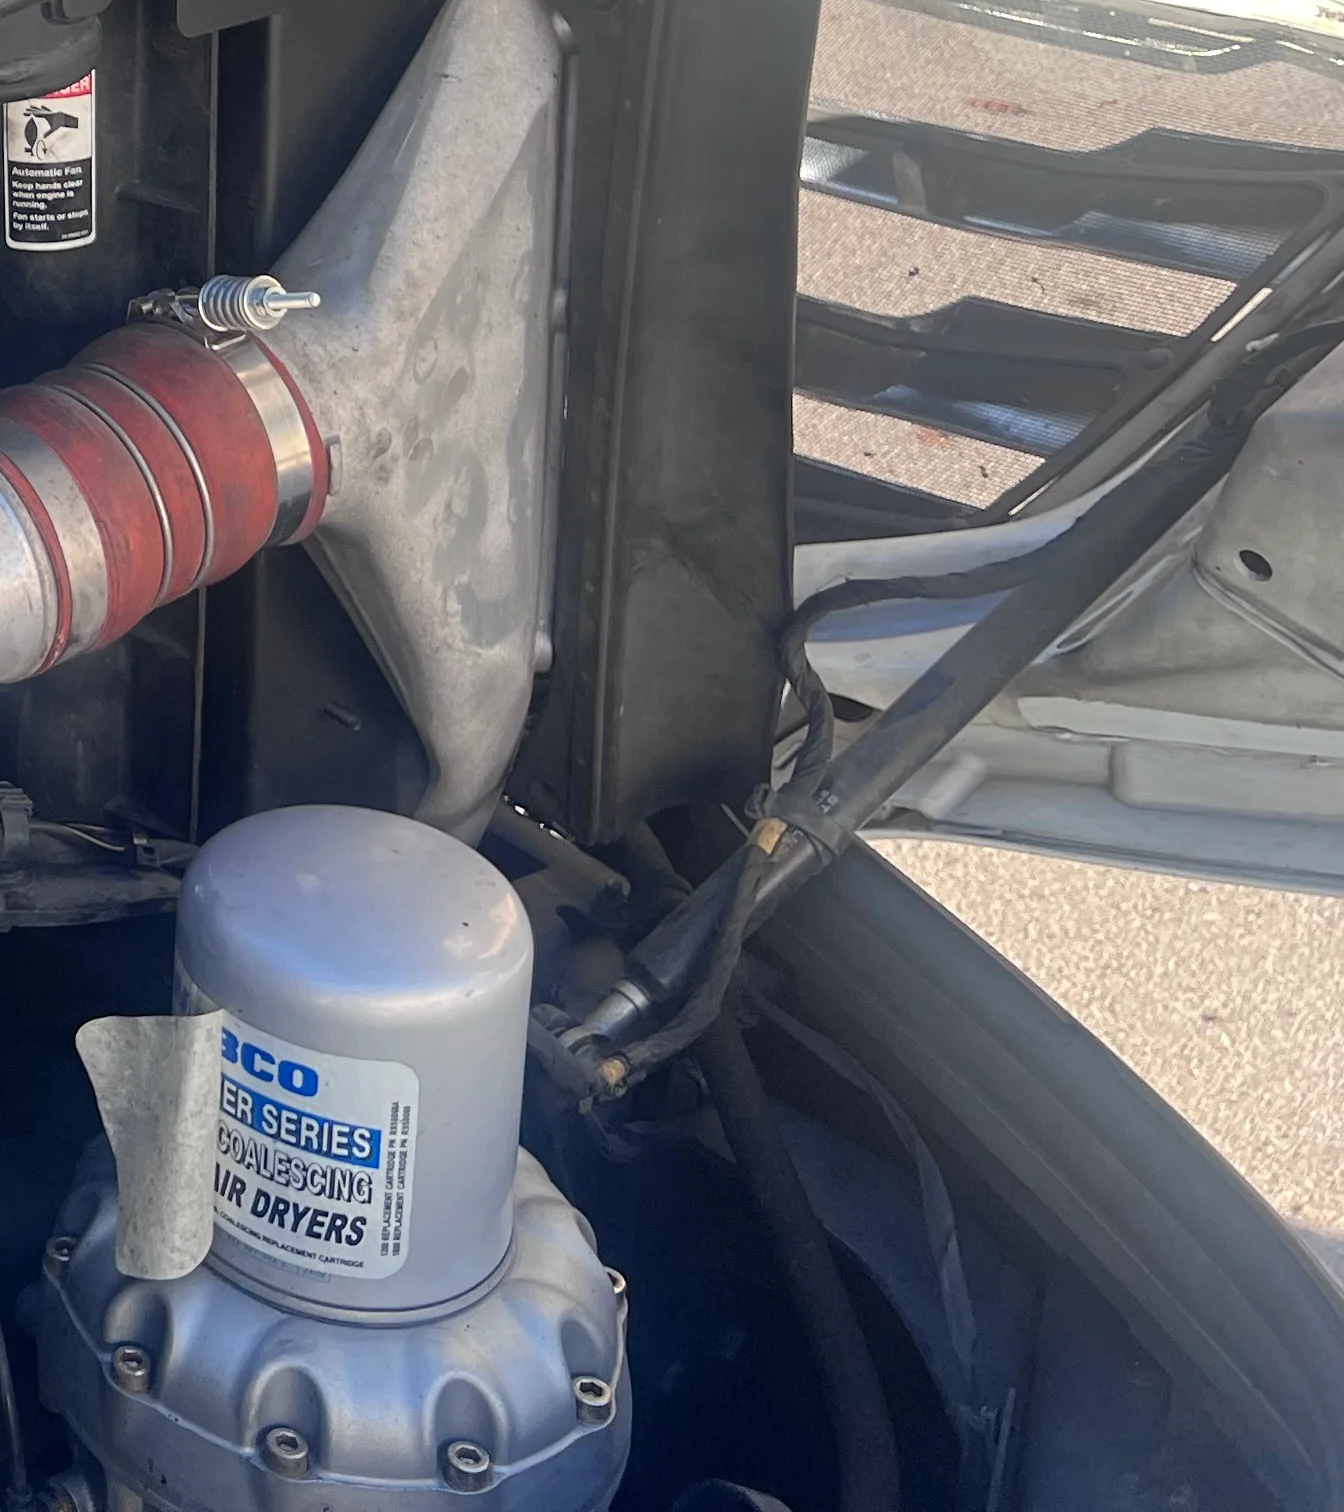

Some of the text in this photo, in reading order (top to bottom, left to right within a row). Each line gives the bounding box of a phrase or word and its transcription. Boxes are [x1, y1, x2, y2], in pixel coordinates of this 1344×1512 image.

[12, 166, 82, 177] Automatic Fan
[12, 180, 34, 191] Keep
[63, 179, 83, 188] clear
[12, 201, 47, 210] running.
[13, 191, 34, 199] when
[36, 192, 65, 201] engine
[13, 212, 28, 221] Fan
[57, 213, 66, 221] or
[67, 209, 89, 219] stops
[13, 221, 23, 231] by
[262, 1104, 371, 1158] SERIES
[216, 1119, 373, 1204] COALESCING
[385, 1150, 396, 1189] CARTRIDGE
[397, 1150, 407, 1189] CARTRIDGE
[250, 1188, 367, 1246] DRYERS
[382, 1192, 393, 1240] REPLACEMENT
[393, 1192, 404, 1240] REPLACEMENT
[220, 1211, 261, 1240] COALESCING
[262, 1235, 317, 1260] REPLACEMENT
[319, 1255, 364, 1268] CARTRIDGE
